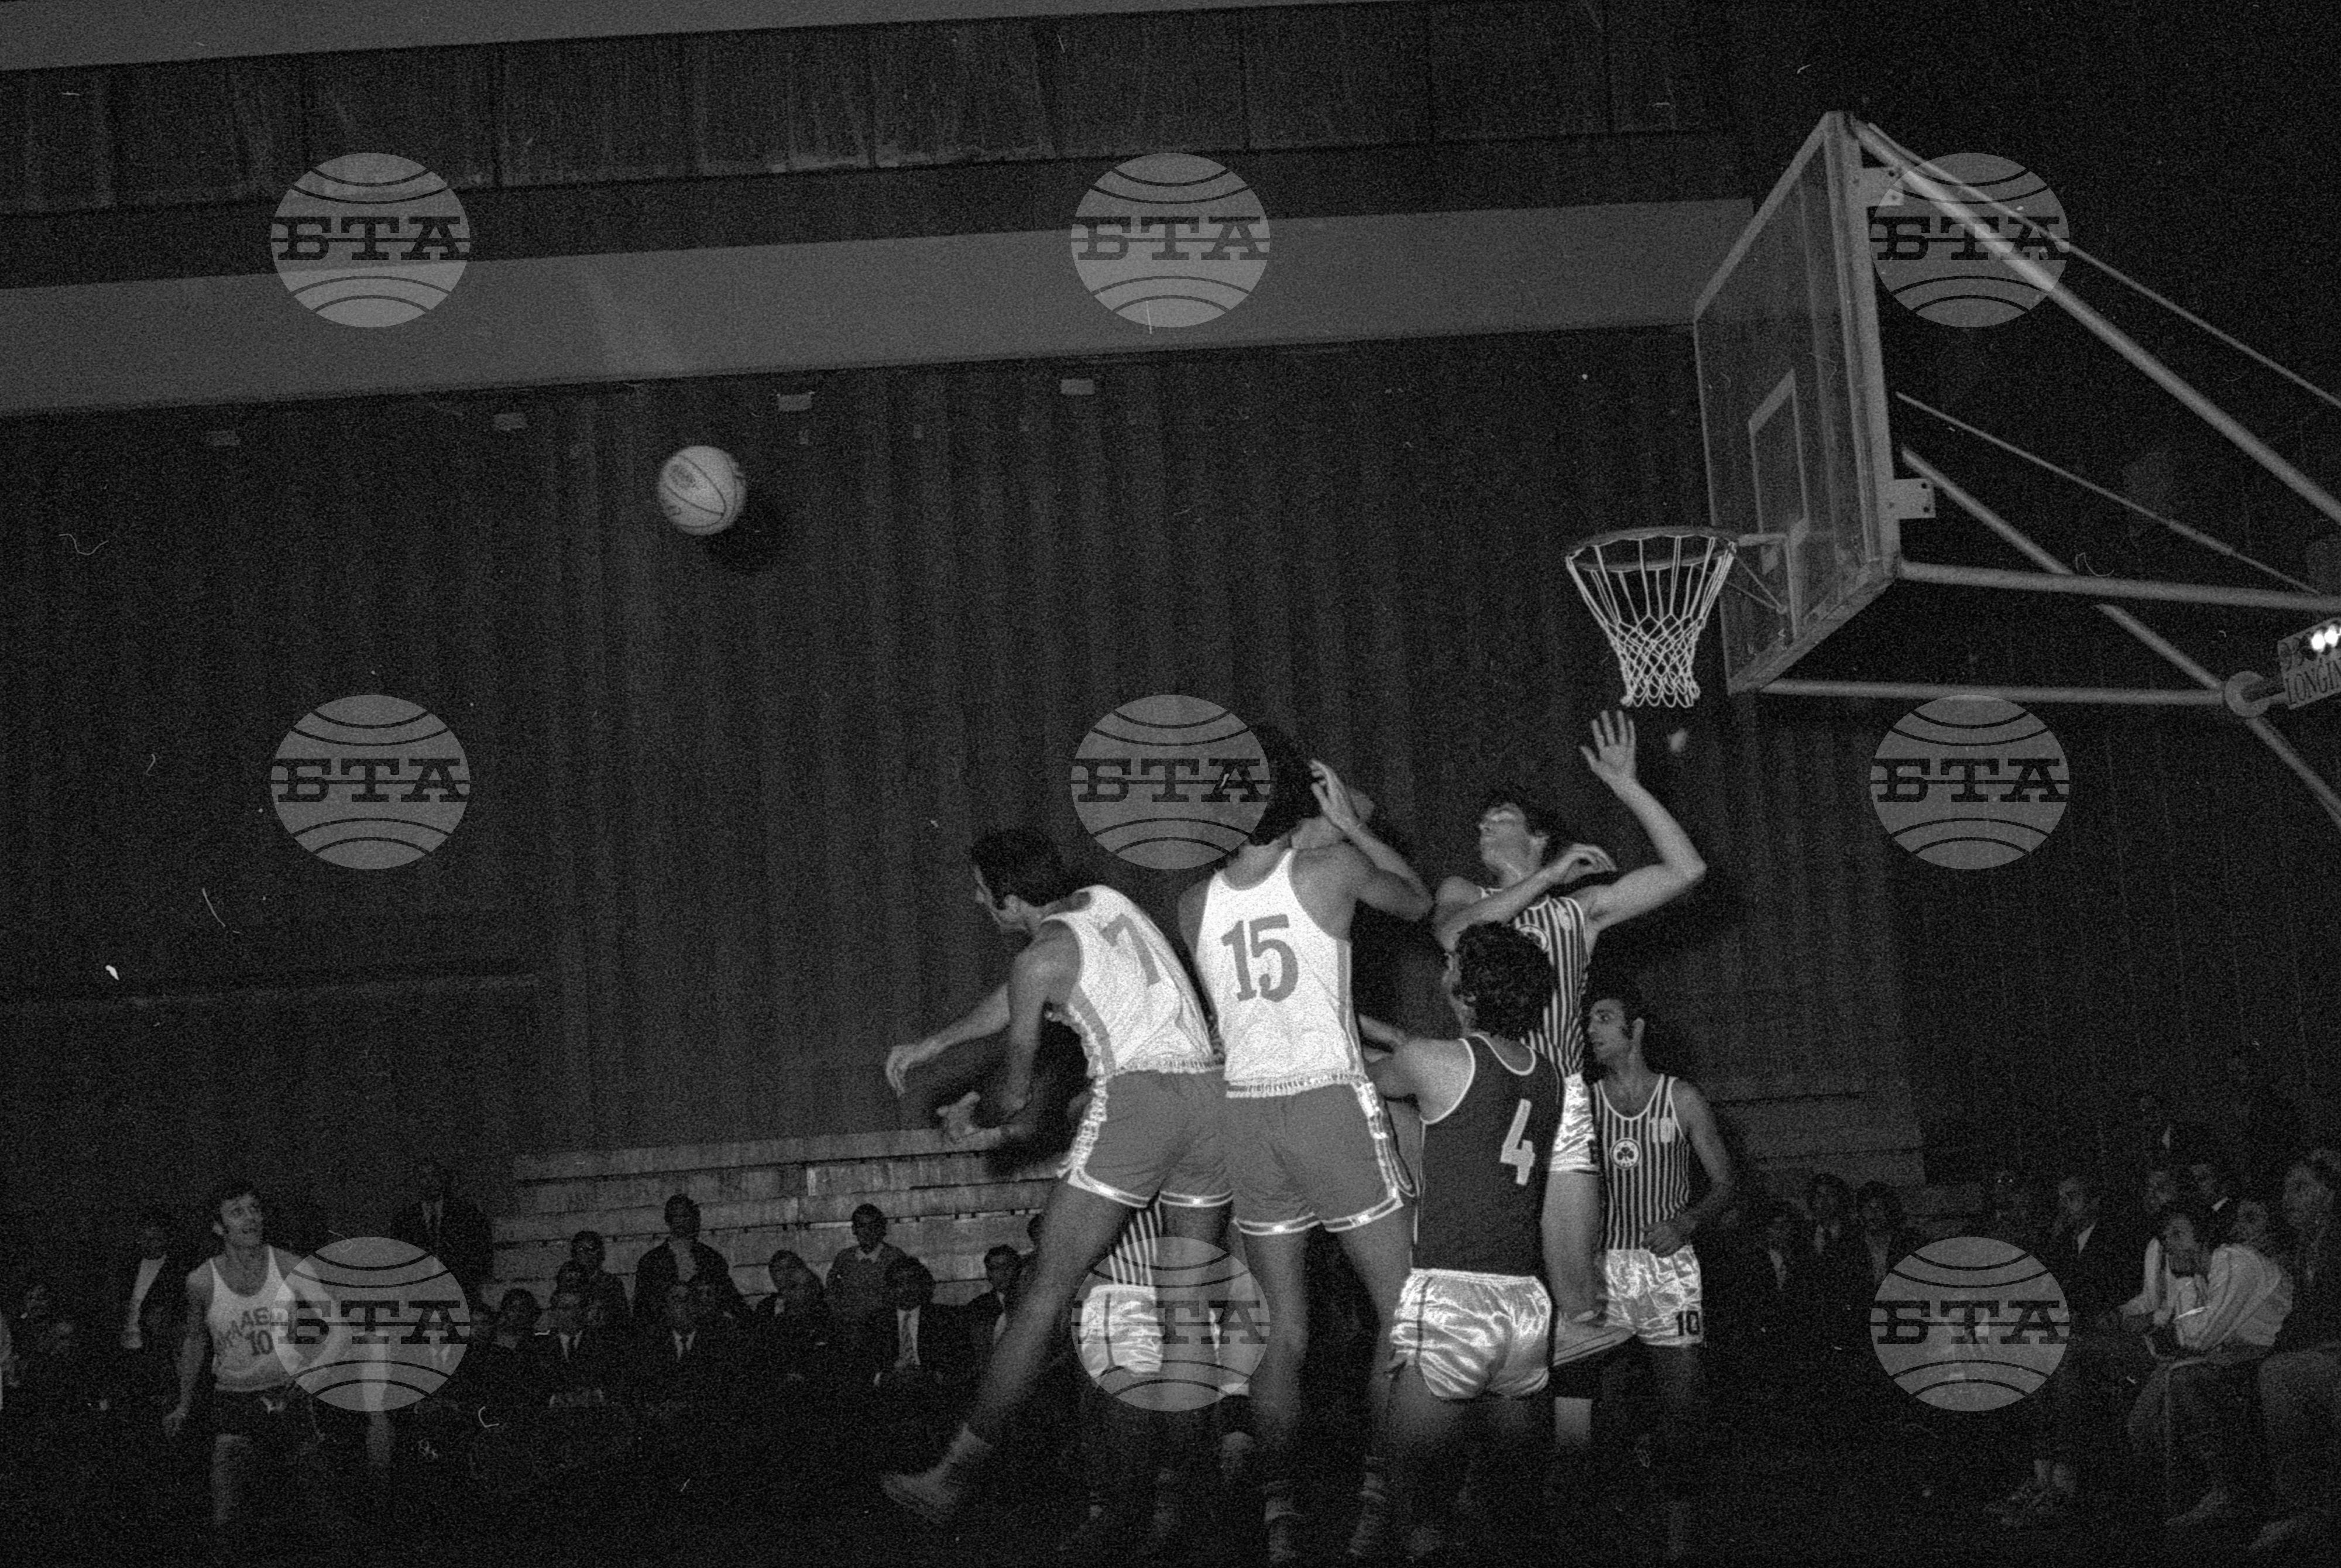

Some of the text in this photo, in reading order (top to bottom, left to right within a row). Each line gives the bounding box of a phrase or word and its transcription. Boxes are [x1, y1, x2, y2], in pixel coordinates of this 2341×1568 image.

[1222, 914, 1299, 1003] 15
[1500, 1098, 1536, 1185] 4
[245, 1330, 273, 1356] 10
[1675, 1310, 1700, 1336] 10
